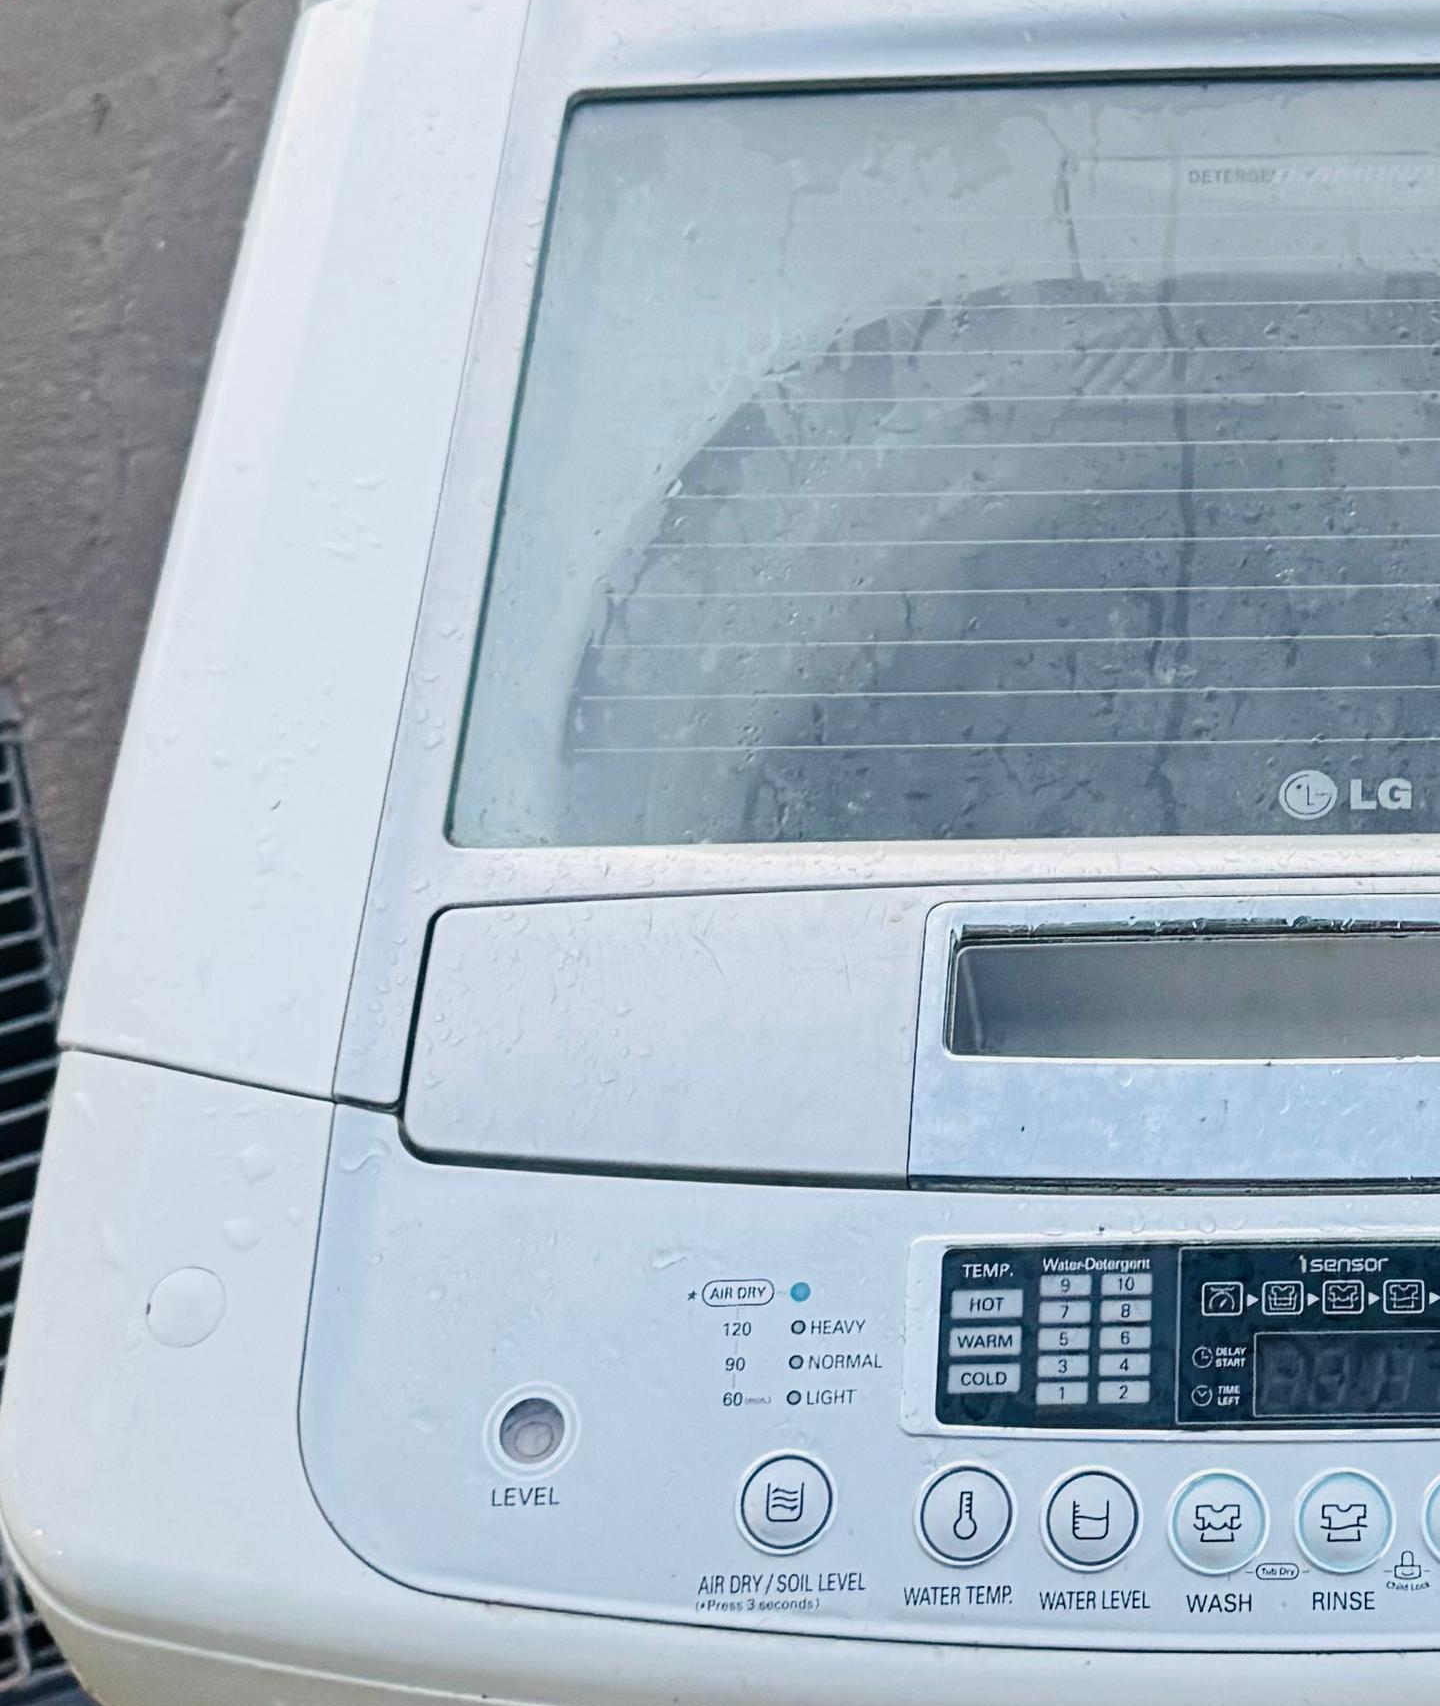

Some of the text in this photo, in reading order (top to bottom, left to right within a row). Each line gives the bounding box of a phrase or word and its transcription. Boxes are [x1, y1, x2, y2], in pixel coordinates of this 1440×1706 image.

[1350, 777, 1413, 810] LG
[962, 1263, 1015, 1278] TEMP.
[1060, 1276, 1071, 1292] 9
[1118, 1276, 1135, 1292] 10
[709, 1285, 767, 1301] AIR DRY
[969, 1296, 1005, 1312] HOT
[1060, 1304, 1070, 1319] 7
[1120, 1304, 1131, 1319] 8
[722, 1321, 752, 1337] 120
[810, 1319, 867, 1335] HEAVY
[957, 1334, 1014, 1350] WARM
[1058, 1330, 1069, 1346] 5
[1120, 1330, 1131, 1345] 6
[1215, 1346, 1247, 1357] DELAY
[724, 1356, 746, 1372] 90
[808, 1354, 883, 1371] NORMAL
[1058, 1358, 1068, 1374] 3
[1119, 1357, 1130, 1372] 4
[1214, 1357, 1247, 1368] START
[960, 1370, 1008, 1386] COLD
[806, 1388, 858, 1405] LIGHT
[1058, 1385, 1065, 1400] 1
[1118, 1385, 1129, 1400] 2
[1217, 1384, 1242, 1395] TIME
[722, 1391, 744, 1407] 60
[1216, 1396, 1241, 1407] LEFT
[490, 1487, 561, 1508] LEVEL
[1279, 1567, 1296, 1578] Dry
[697, 1574, 725, 1595] AIR
[729, 1573, 764, 1594] DRY
[776, 1572, 814, 1593] SOIL
[818, 1572, 867, 1593] LEVEL
[903, 1584, 1014, 1606] WATER TEMP.
[1039, 1589, 1152, 1611] WATER LEVEL
[1311, 1591, 1376, 1611] RINSE
[747, 1598, 756, 1611] 3
[758, 1597, 821, 1611] seconds)
[1186, 1593, 1253, 1614] WASH
